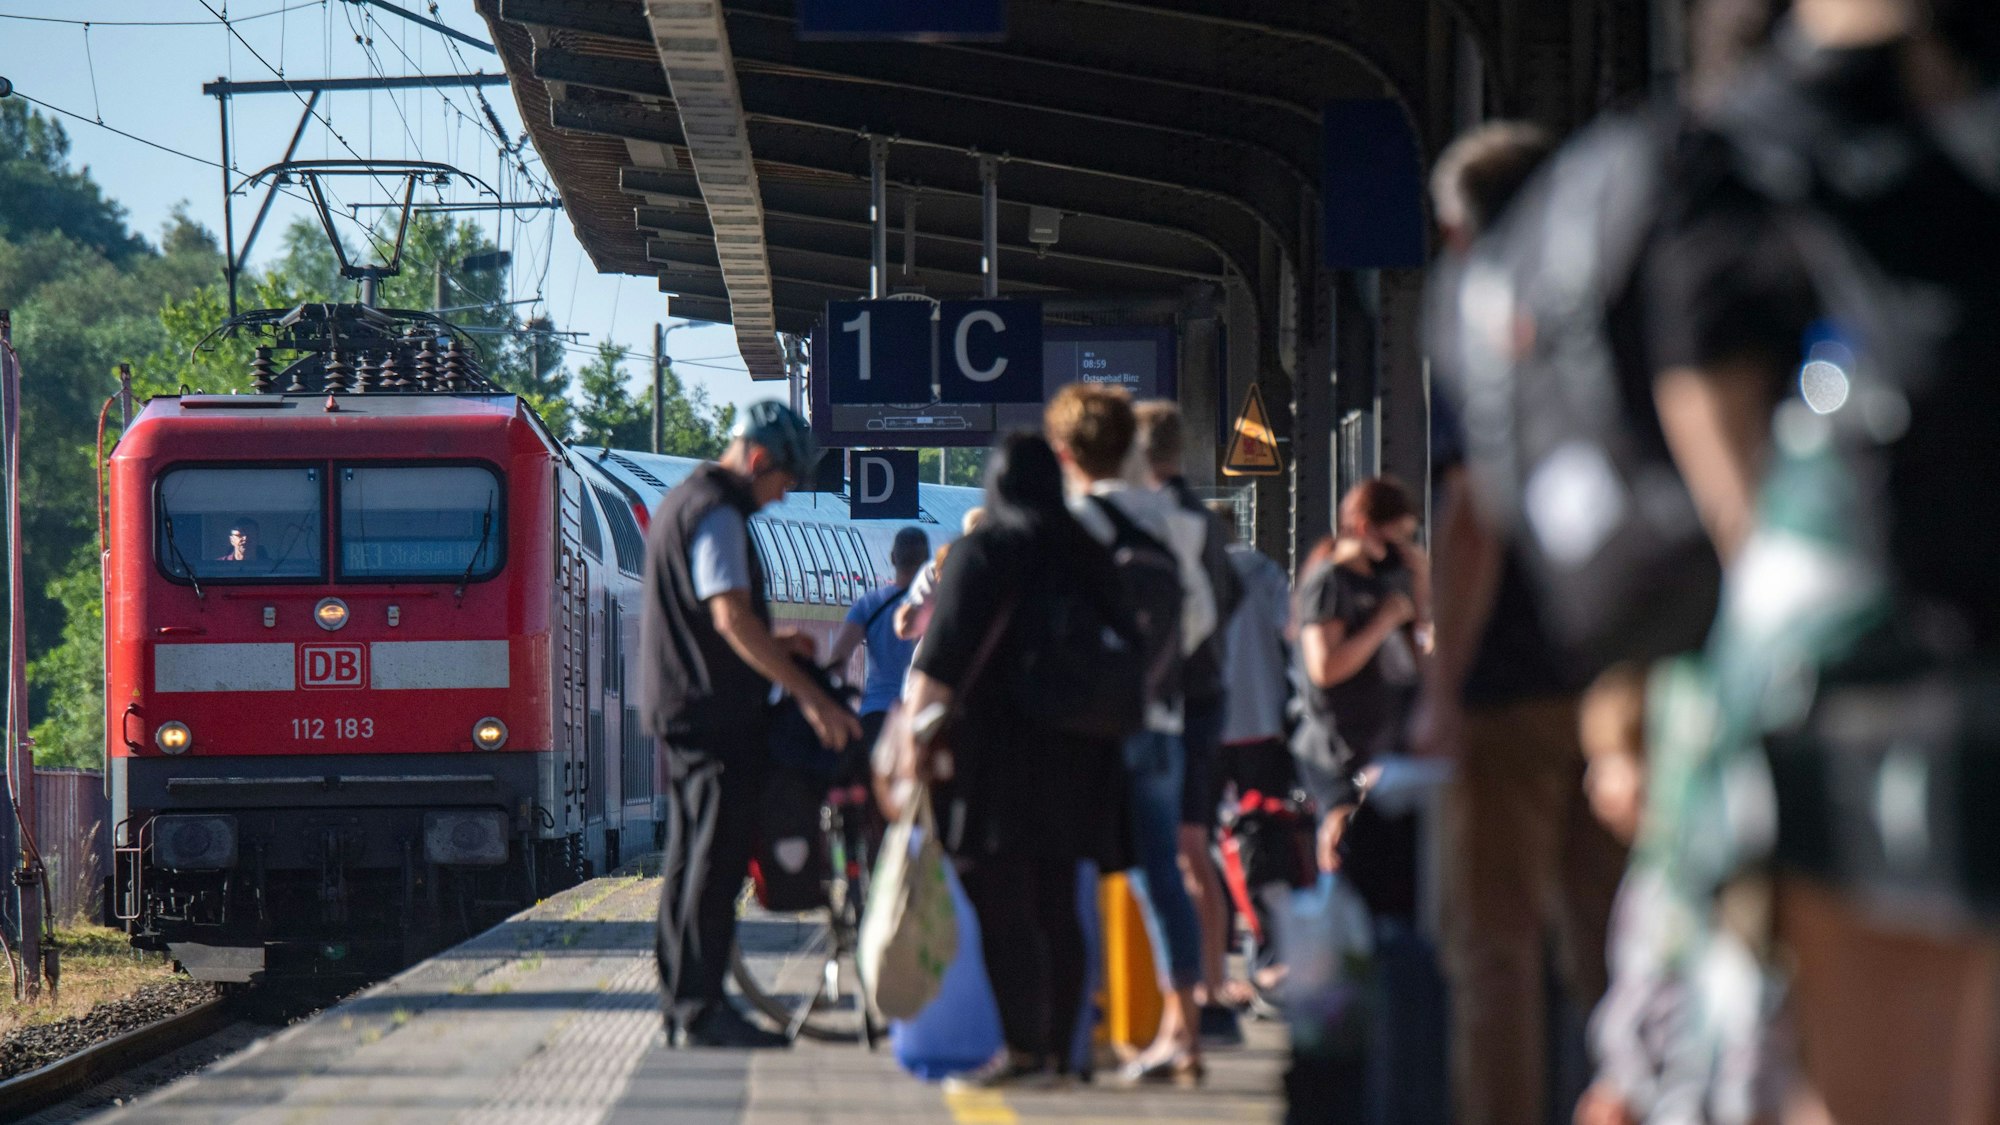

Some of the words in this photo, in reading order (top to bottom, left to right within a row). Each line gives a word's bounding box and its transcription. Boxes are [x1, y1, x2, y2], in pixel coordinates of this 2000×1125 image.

[842, 310, 871, 381] 1
[954, 309, 1009, 382] C
[1083, 359, 1106, 369] 08:59
[1083, 373, 1121, 383] Ostseebad
[1123, 373, 1139, 383] Binz
[859, 456, 895, 504] D
[350, 543, 382, 569] RE3
[390, 544, 453, 564] Stralsund
[308, 650, 358, 681] DB
[292, 718, 325, 739] 112
[335, 717, 374, 739] 183
